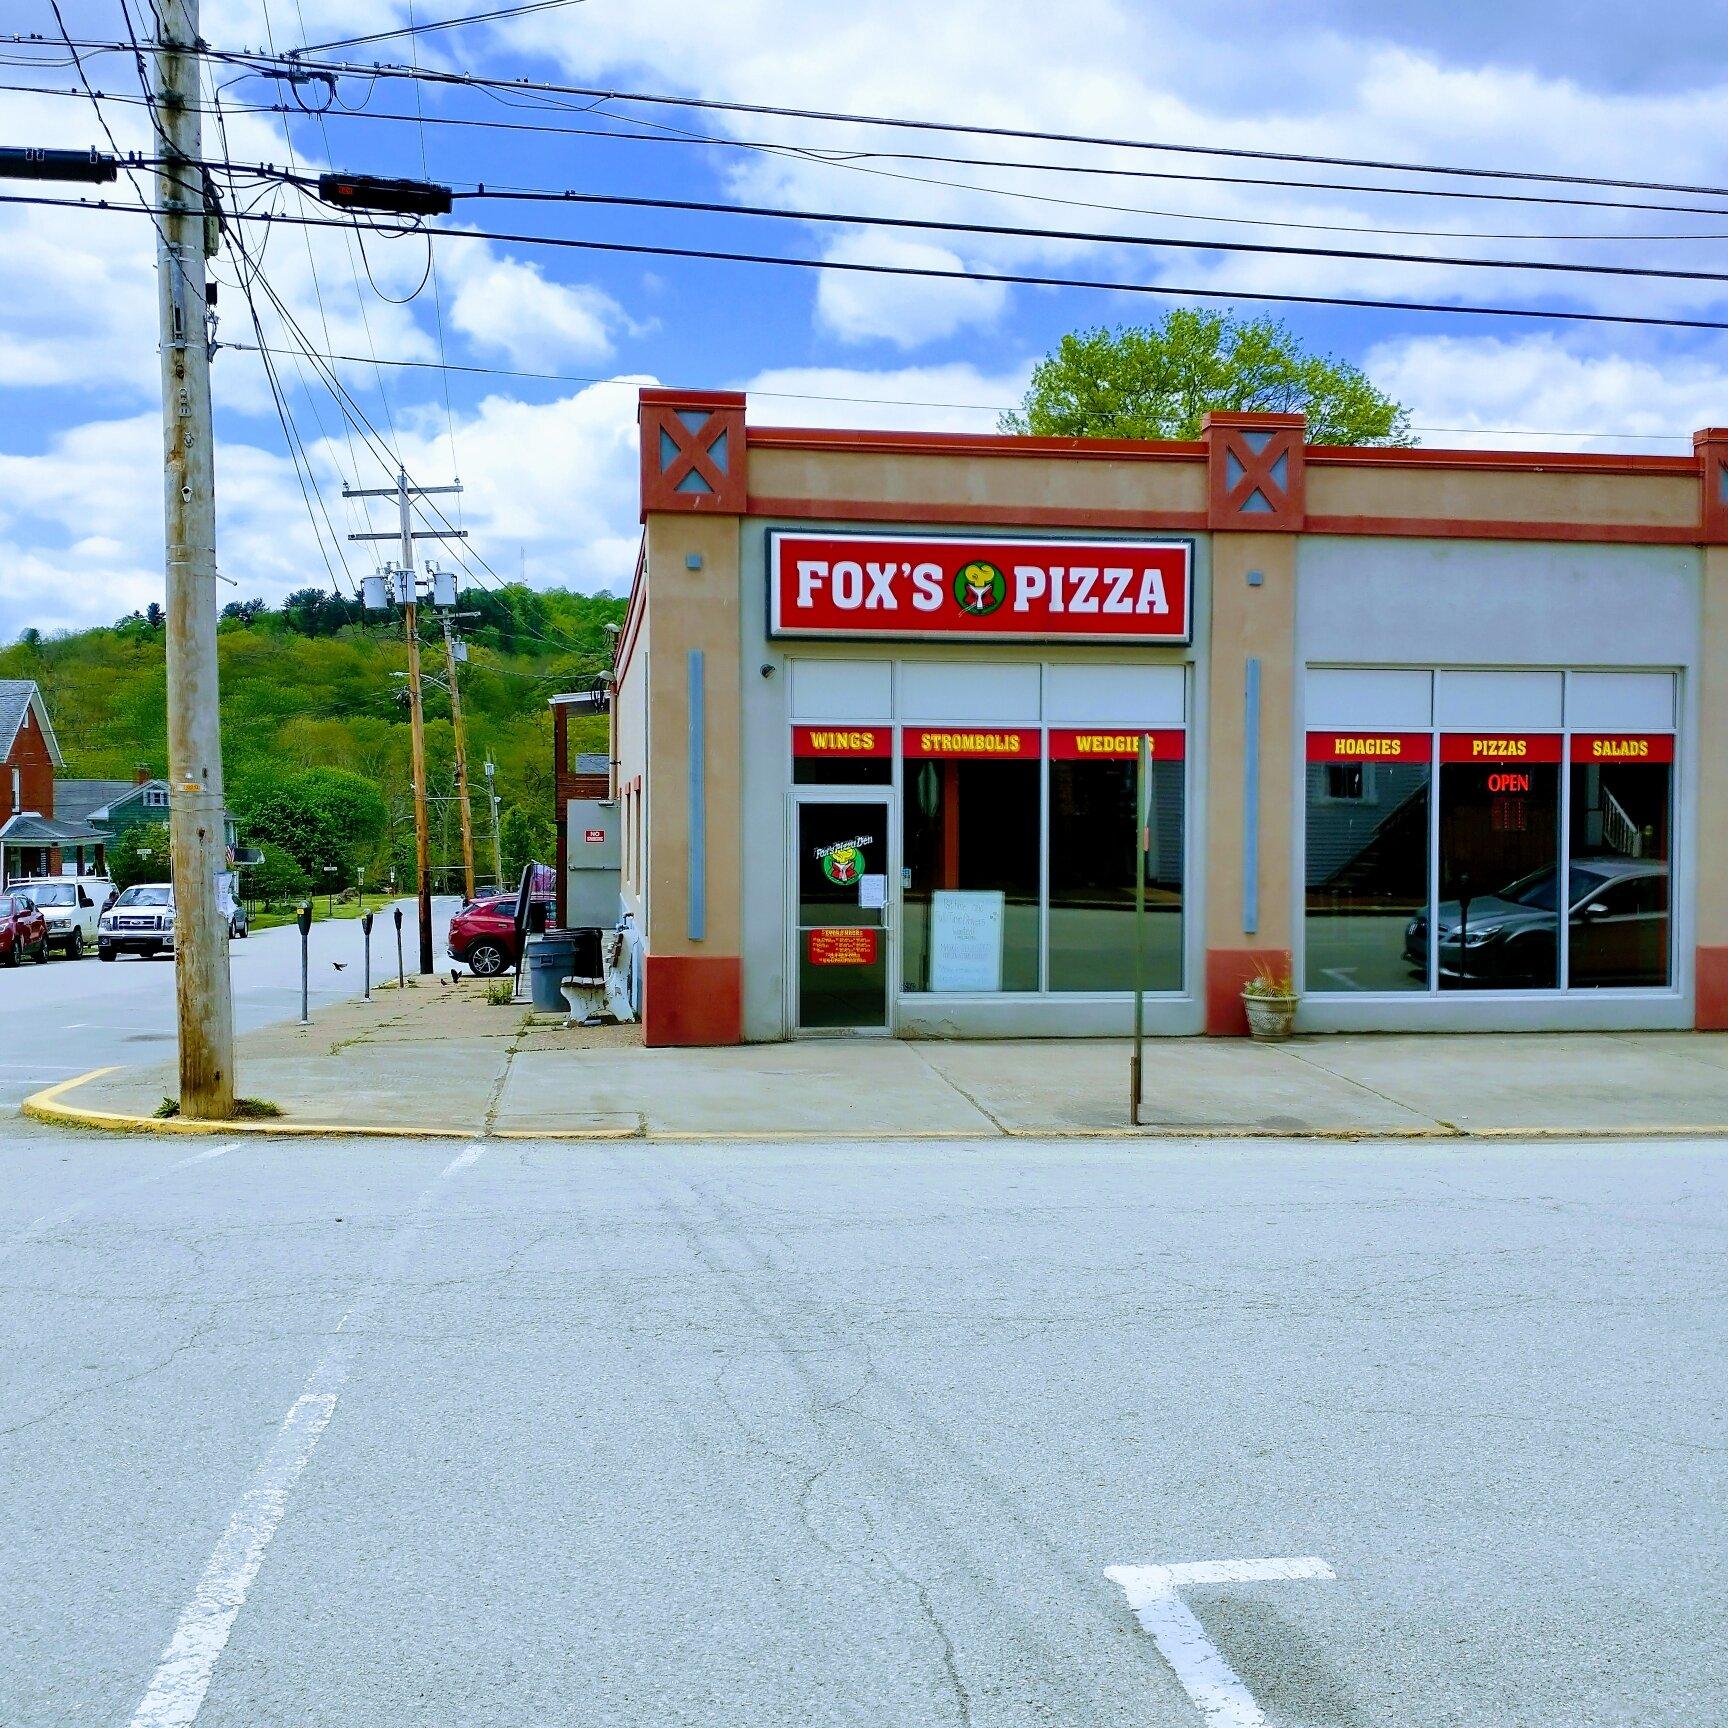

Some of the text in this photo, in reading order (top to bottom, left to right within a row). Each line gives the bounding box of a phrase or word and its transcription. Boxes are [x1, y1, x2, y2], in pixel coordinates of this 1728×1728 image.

[796, 561, 1170, 615] FOX'S PIZZA
[810, 733, 876, 750] WINGS
[921, 734, 1021, 753] STROMBOLIS
[1334, 739, 1402, 755] HOAGIES
[1472, 740, 1527, 756] PIZZAS
[1592, 740, 1649, 757] SALADS
[1488, 774, 1529, 792] OPEN
[855, 836, 873, 848] Den
